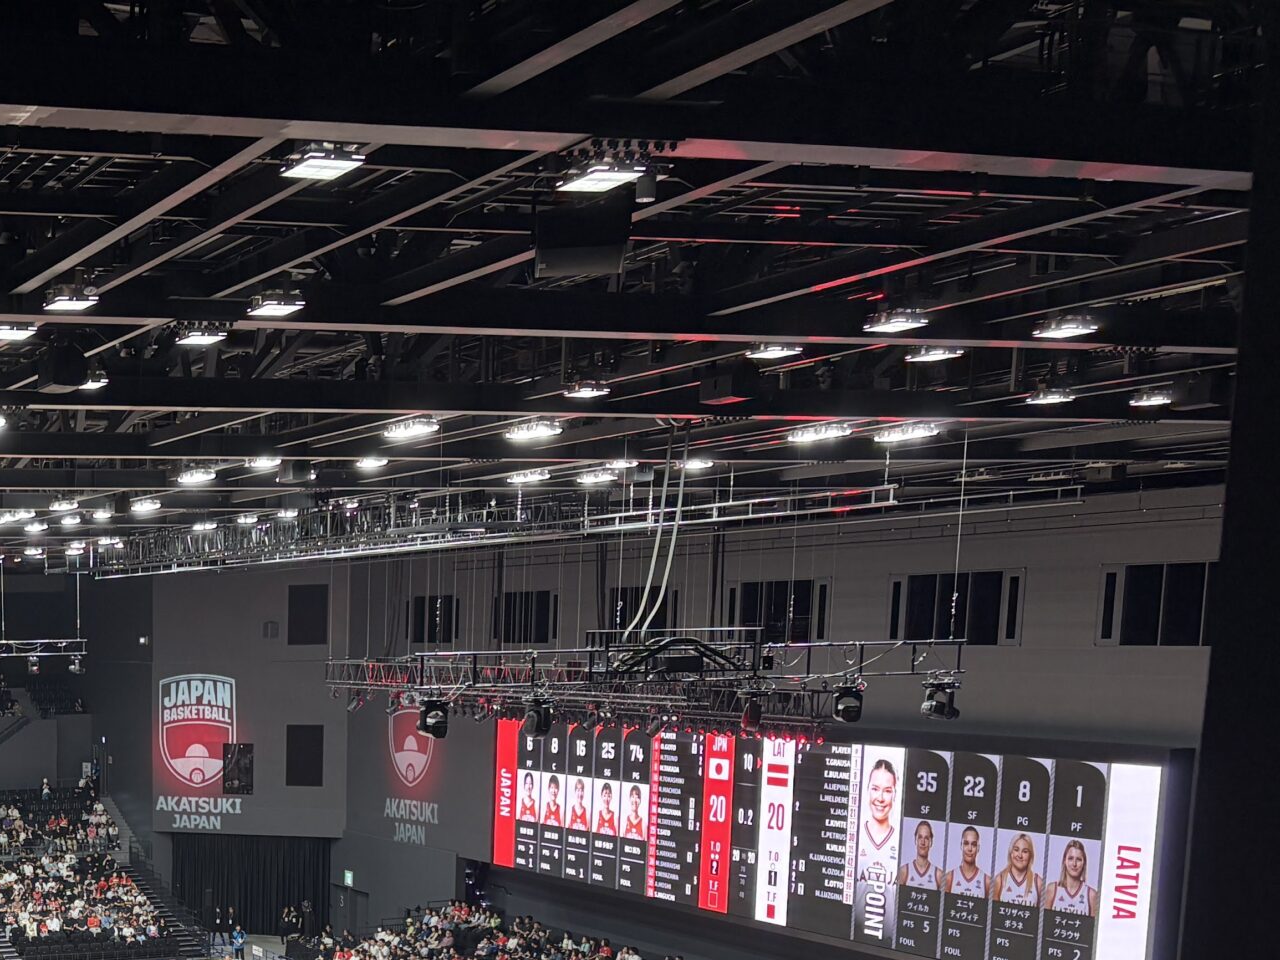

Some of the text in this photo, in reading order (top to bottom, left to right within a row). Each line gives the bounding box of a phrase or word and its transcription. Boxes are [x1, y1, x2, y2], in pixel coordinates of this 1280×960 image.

[164, 680, 230, 708] JAPAN
[164, 706, 231, 723] BASKETBALL
[526, 737, 533, 751] 6
[551, 738, 558, 753] 8
[576, 740, 586, 756] 16
[602, 743, 615, 759] 25
[713, 736, 727, 752] JPN
[773, 740, 785, 757] LAT
[630, 745, 644, 762] 74
[744, 753, 753, 772] 1Q
[917, 772, 937, 792] 35
[963, 776, 984, 797] 22
[500, 768, 512, 817] JAPAN
[1019, 781, 1030, 802] 8
[1076, 785, 1083, 807] 1
[156, 796, 242, 814] AKATSUKI
[384, 798, 438, 824] AKATSUKI
[710, 795, 726, 822] 20
[921, 805, 930, 814] SF
[172, 814, 221, 830] JAPAN
[738, 808, 753, 825] 0.2
[768, 802, 784, 830] 20
[968, 811, 977, 820] SF
[1017, 816, 1028, 826] PG
[394, 822, 426, 845] JAPAN
[1072, 822, 1082, 831] PF
[529, 845, 533, 854] 2
[554, 850, 558, 859] 4
[712, 861, 716, 874] 2
[1112, 845, 1141, 919] LATVIA
[864, 880, 885, 940] POINT
[903, 920, 930, 932] PTS 5
[1055, 916, 1081, 927] ティーナ
[948, 929, 960, 937] PTS
[900, 938, 915, 947] FOUL
[997, 938, 1009, 947] PTS
[945, 947, 961, 956] FOUL
[1048, 948, 1062, 957] PTS
